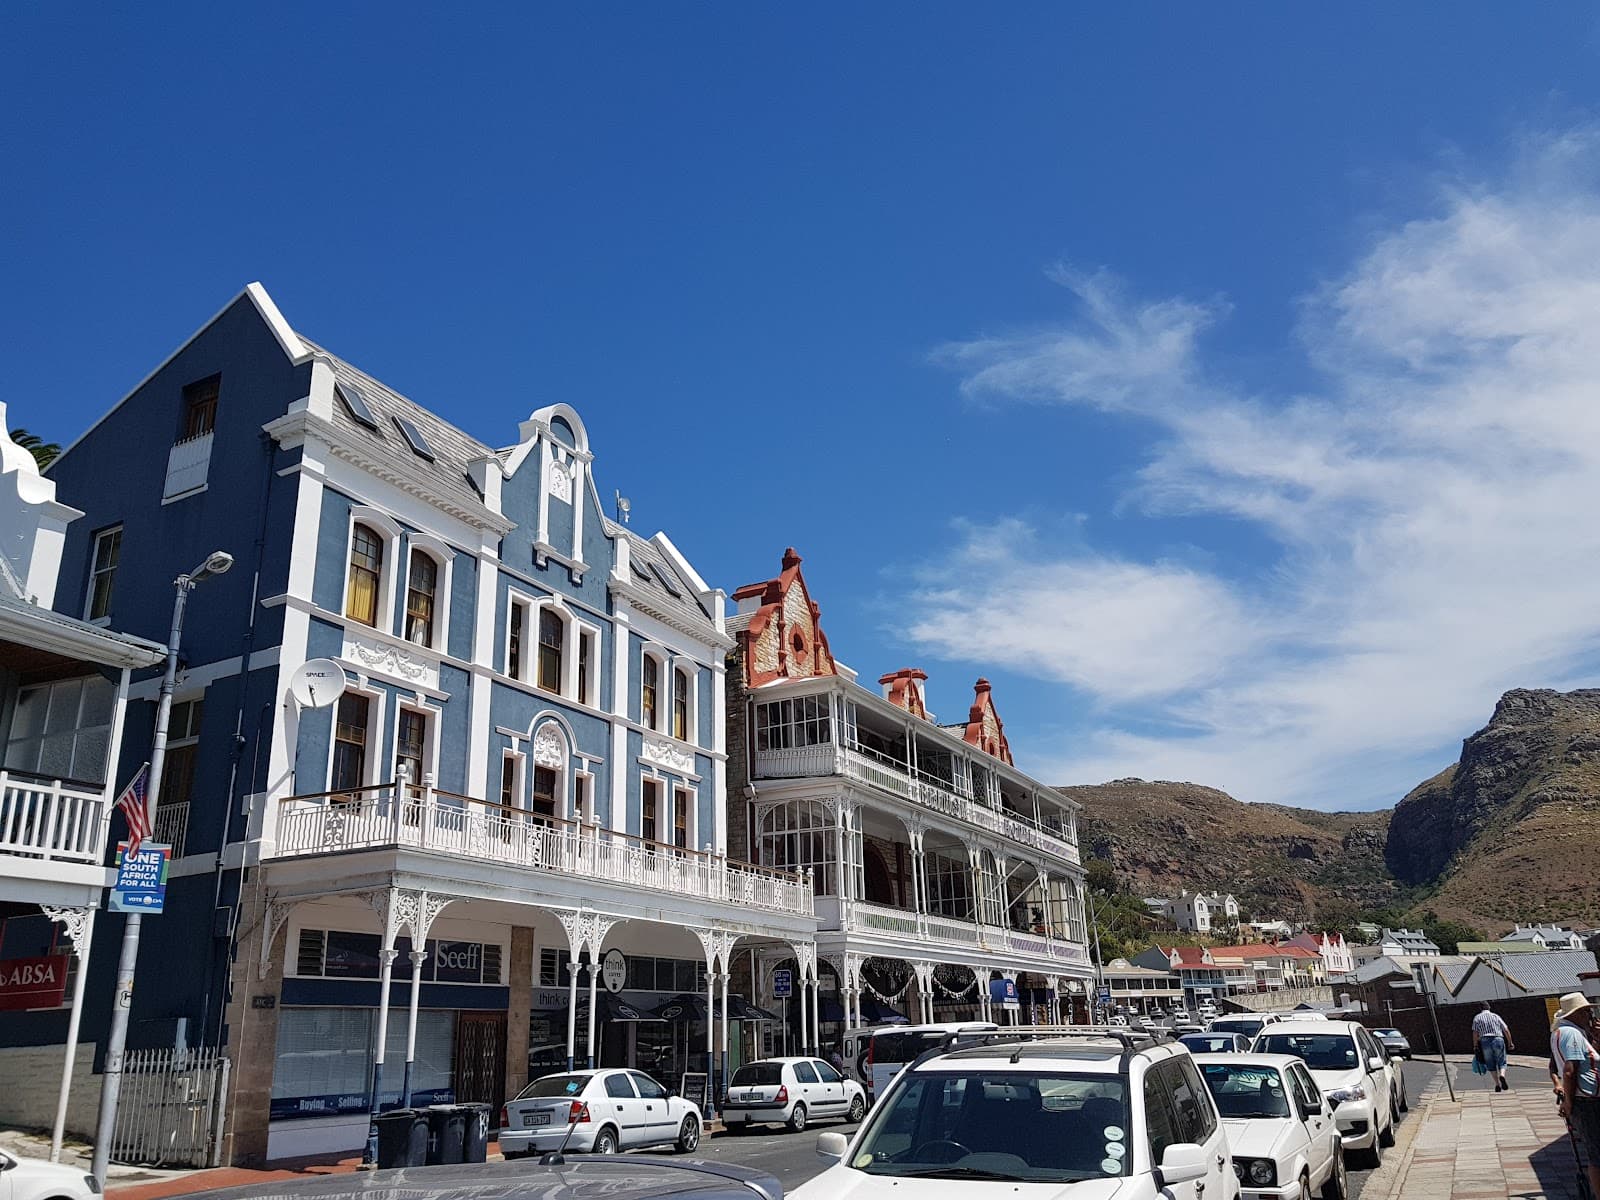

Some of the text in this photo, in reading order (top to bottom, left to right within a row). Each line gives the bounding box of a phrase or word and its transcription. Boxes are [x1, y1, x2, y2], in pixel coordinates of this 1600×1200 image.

[125, 852, 161, 864] ONE
[123, 863, 159, 872] SOUTH
[122, 871, 157, 880] AFRICA
[437, 943, 480, 970] Seeff
[605, 959, 625, 971] think
[8, 963, 56, 986] ABSA
[539, 991, 560, 1006] think
[300, 1100, 325, 1111] Buying
[338, 1097, 363, 1108] Selling
